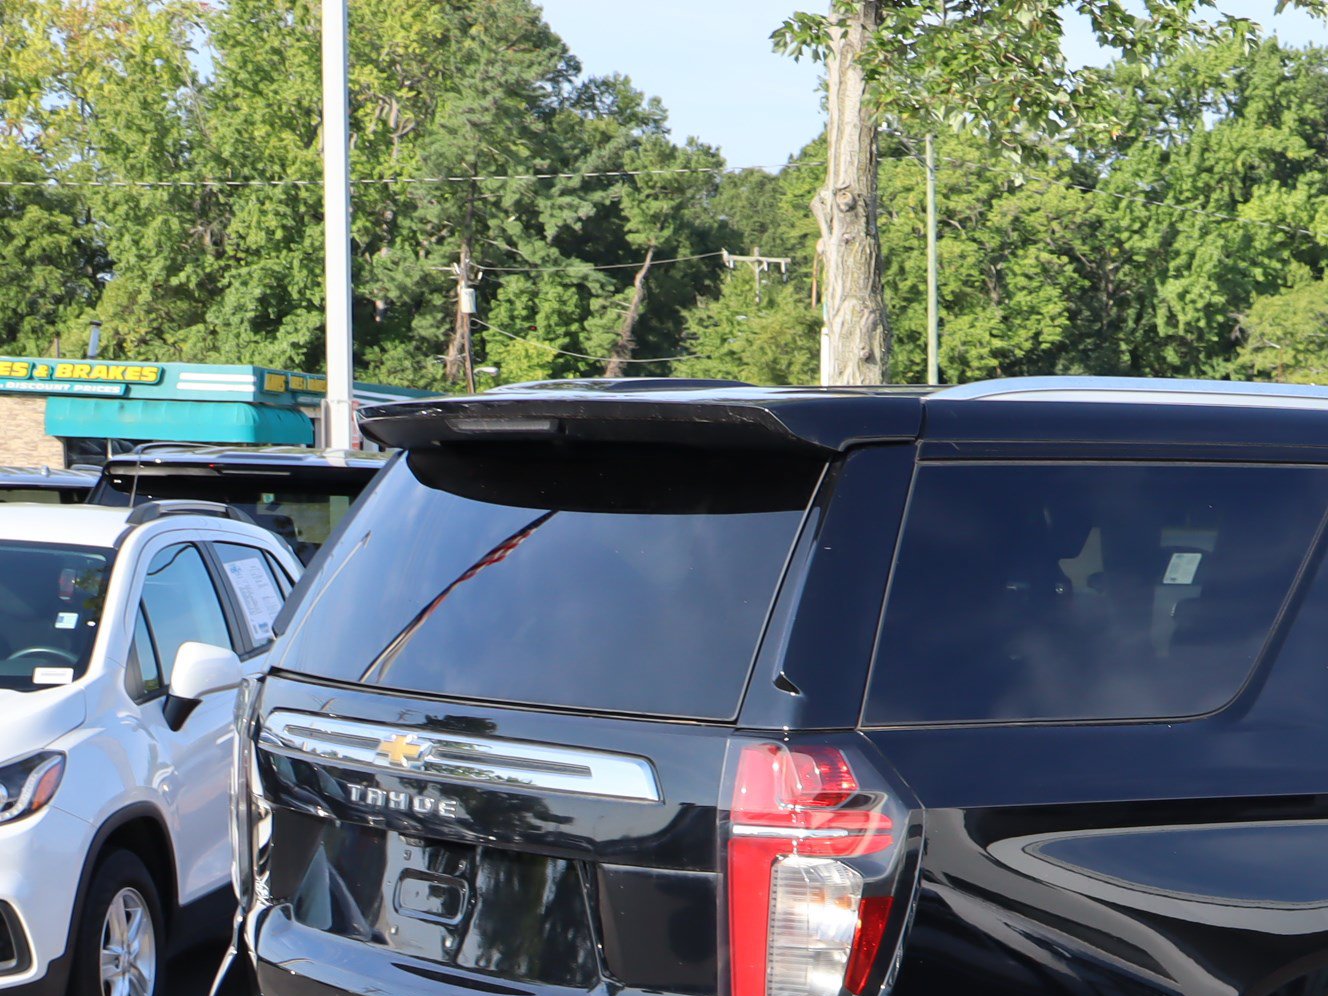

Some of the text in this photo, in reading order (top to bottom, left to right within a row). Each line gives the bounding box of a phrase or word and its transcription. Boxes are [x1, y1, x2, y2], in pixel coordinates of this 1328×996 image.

[33, 364, 49, 378] &
[54, 363, 159, 382] BRAKES
[5, 381, 121, 393] DISCOUNT PRICES
[347, 783, 457, 819] TAHOE
